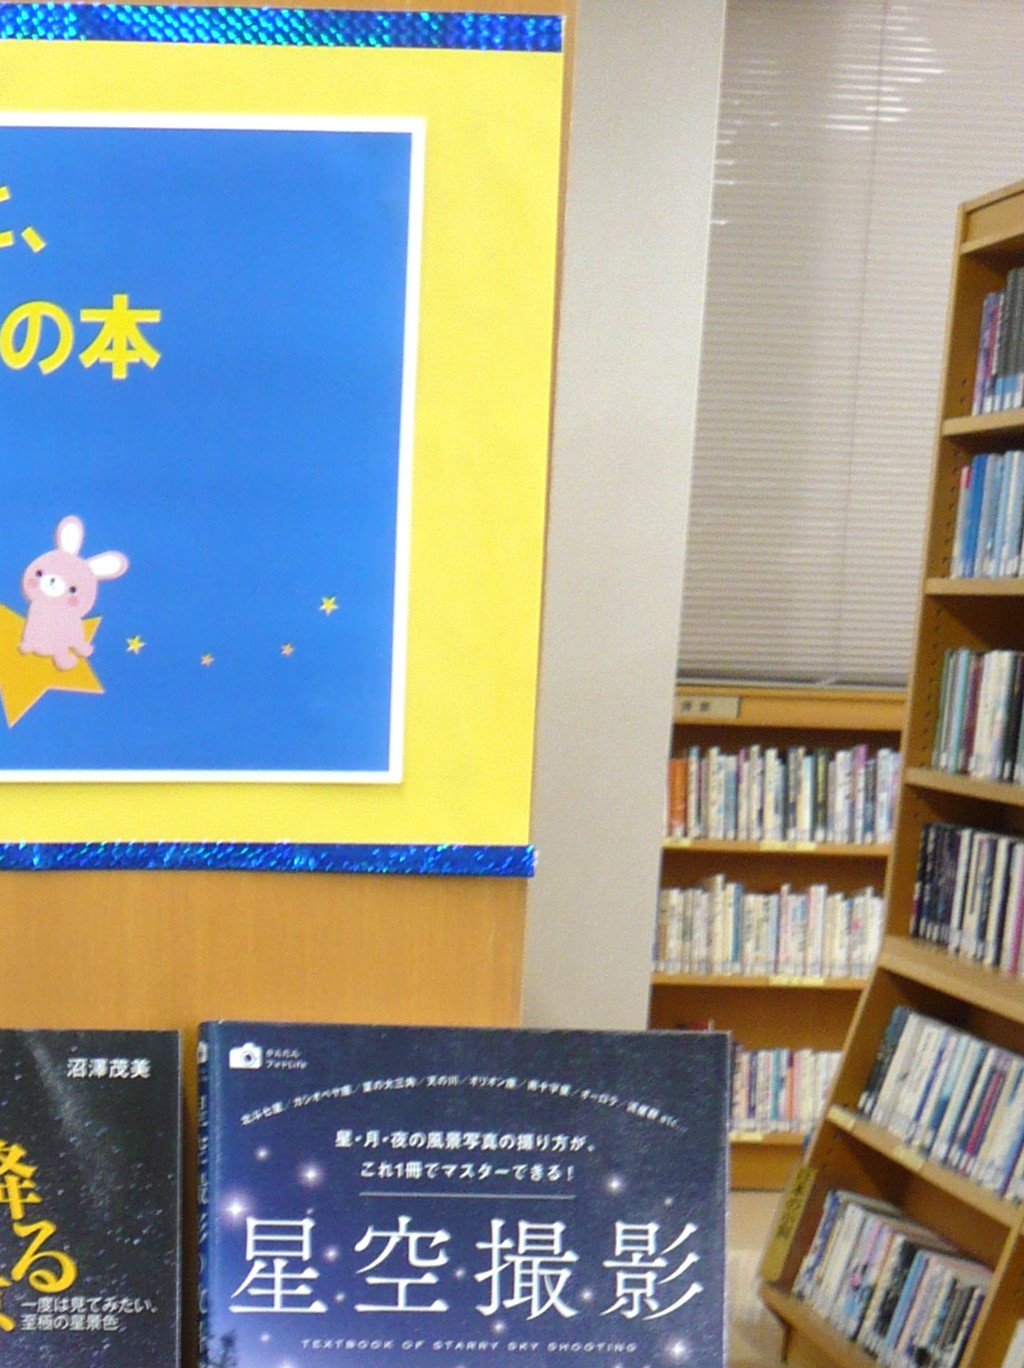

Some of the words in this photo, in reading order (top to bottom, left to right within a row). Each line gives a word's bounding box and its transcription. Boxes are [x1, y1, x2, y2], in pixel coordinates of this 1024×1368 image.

[67, 1058, 151, 1079] 沼澤茂美
[228, 1216, 704, 1321] 星空撮影
[301, 1338, 394, 1350] TEXTBOOK
[401, 1339, 425, 1350] OF
[432, 1340, 499, 1351] STARRY
[507, 1341, 539, 1352] SKY
[547, 1341, 638, 1353] SHOOTING
